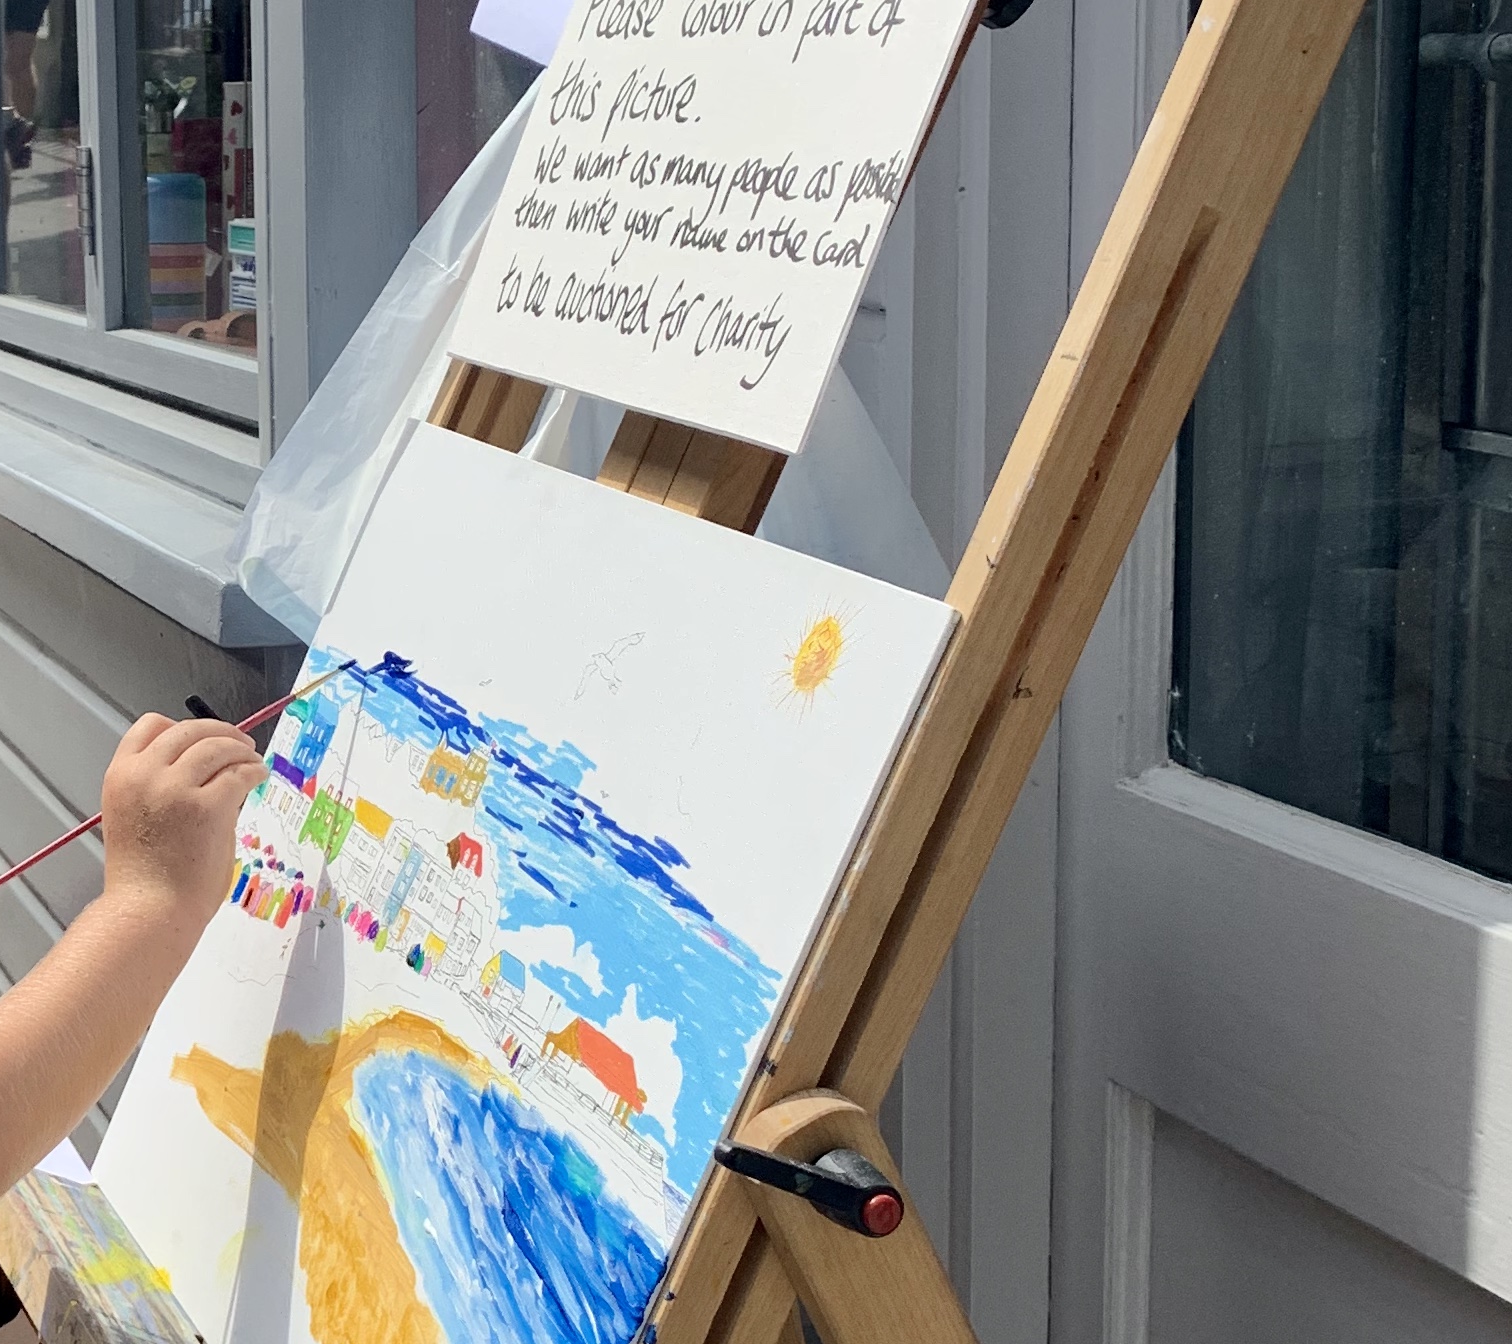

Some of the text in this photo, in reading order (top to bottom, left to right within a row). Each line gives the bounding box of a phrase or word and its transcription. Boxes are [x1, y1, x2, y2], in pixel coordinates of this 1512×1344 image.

[549, 58, 602, 125] this
[534, 135, 567, 185] We
[572, 144, 631, 182] want
[630, 149, 662, 189] as
[660, 154, 728, 226] many
[719, 150, 799, 221] people
[803, 160, 843, 203] as
[514, 188, 557, 231] then
[565, 188, 618, 236] write
[611, 206, 675, 268] your
[735, 227, 765, 253] on
[768, 215, 808, 263] the
[496, 252, 523, 314] to
[524, 254, 552, 318] be
[652, 278, 706, 354] for
